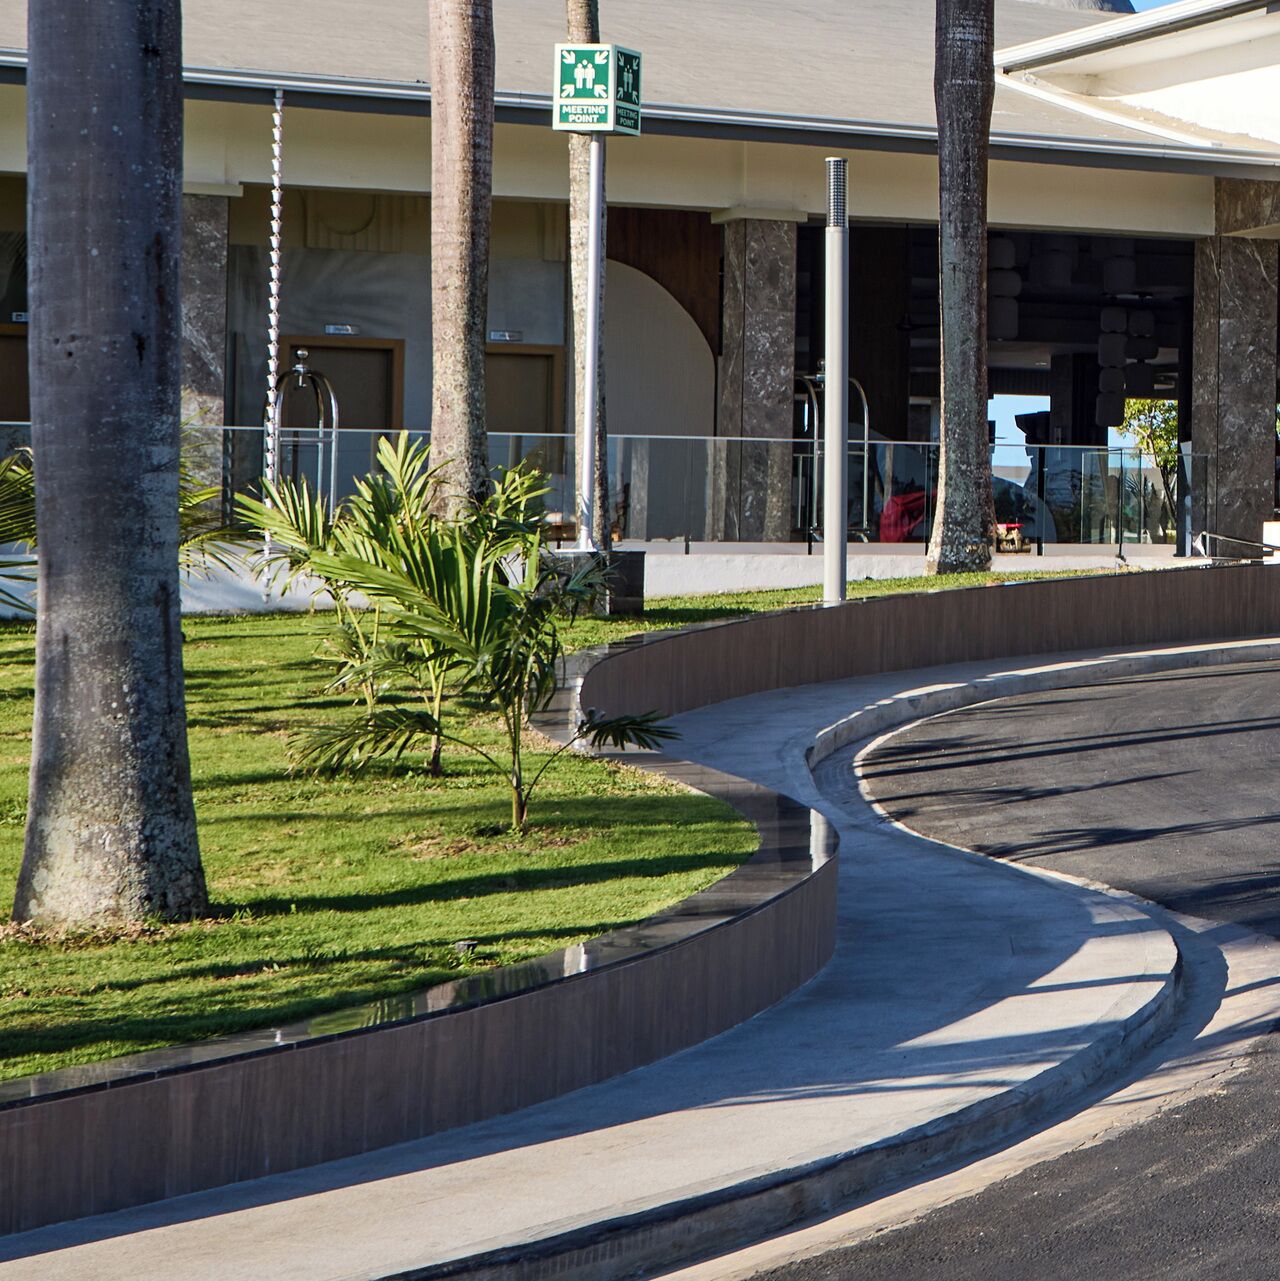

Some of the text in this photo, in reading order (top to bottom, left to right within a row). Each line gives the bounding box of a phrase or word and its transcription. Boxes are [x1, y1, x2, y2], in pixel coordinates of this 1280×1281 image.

[562, 105, 606, 114] MEETING
[617, 108, 638, 120] MEETING
[568, 114, 599, 123] POINT
[620, 117, 635, 127] POINT
